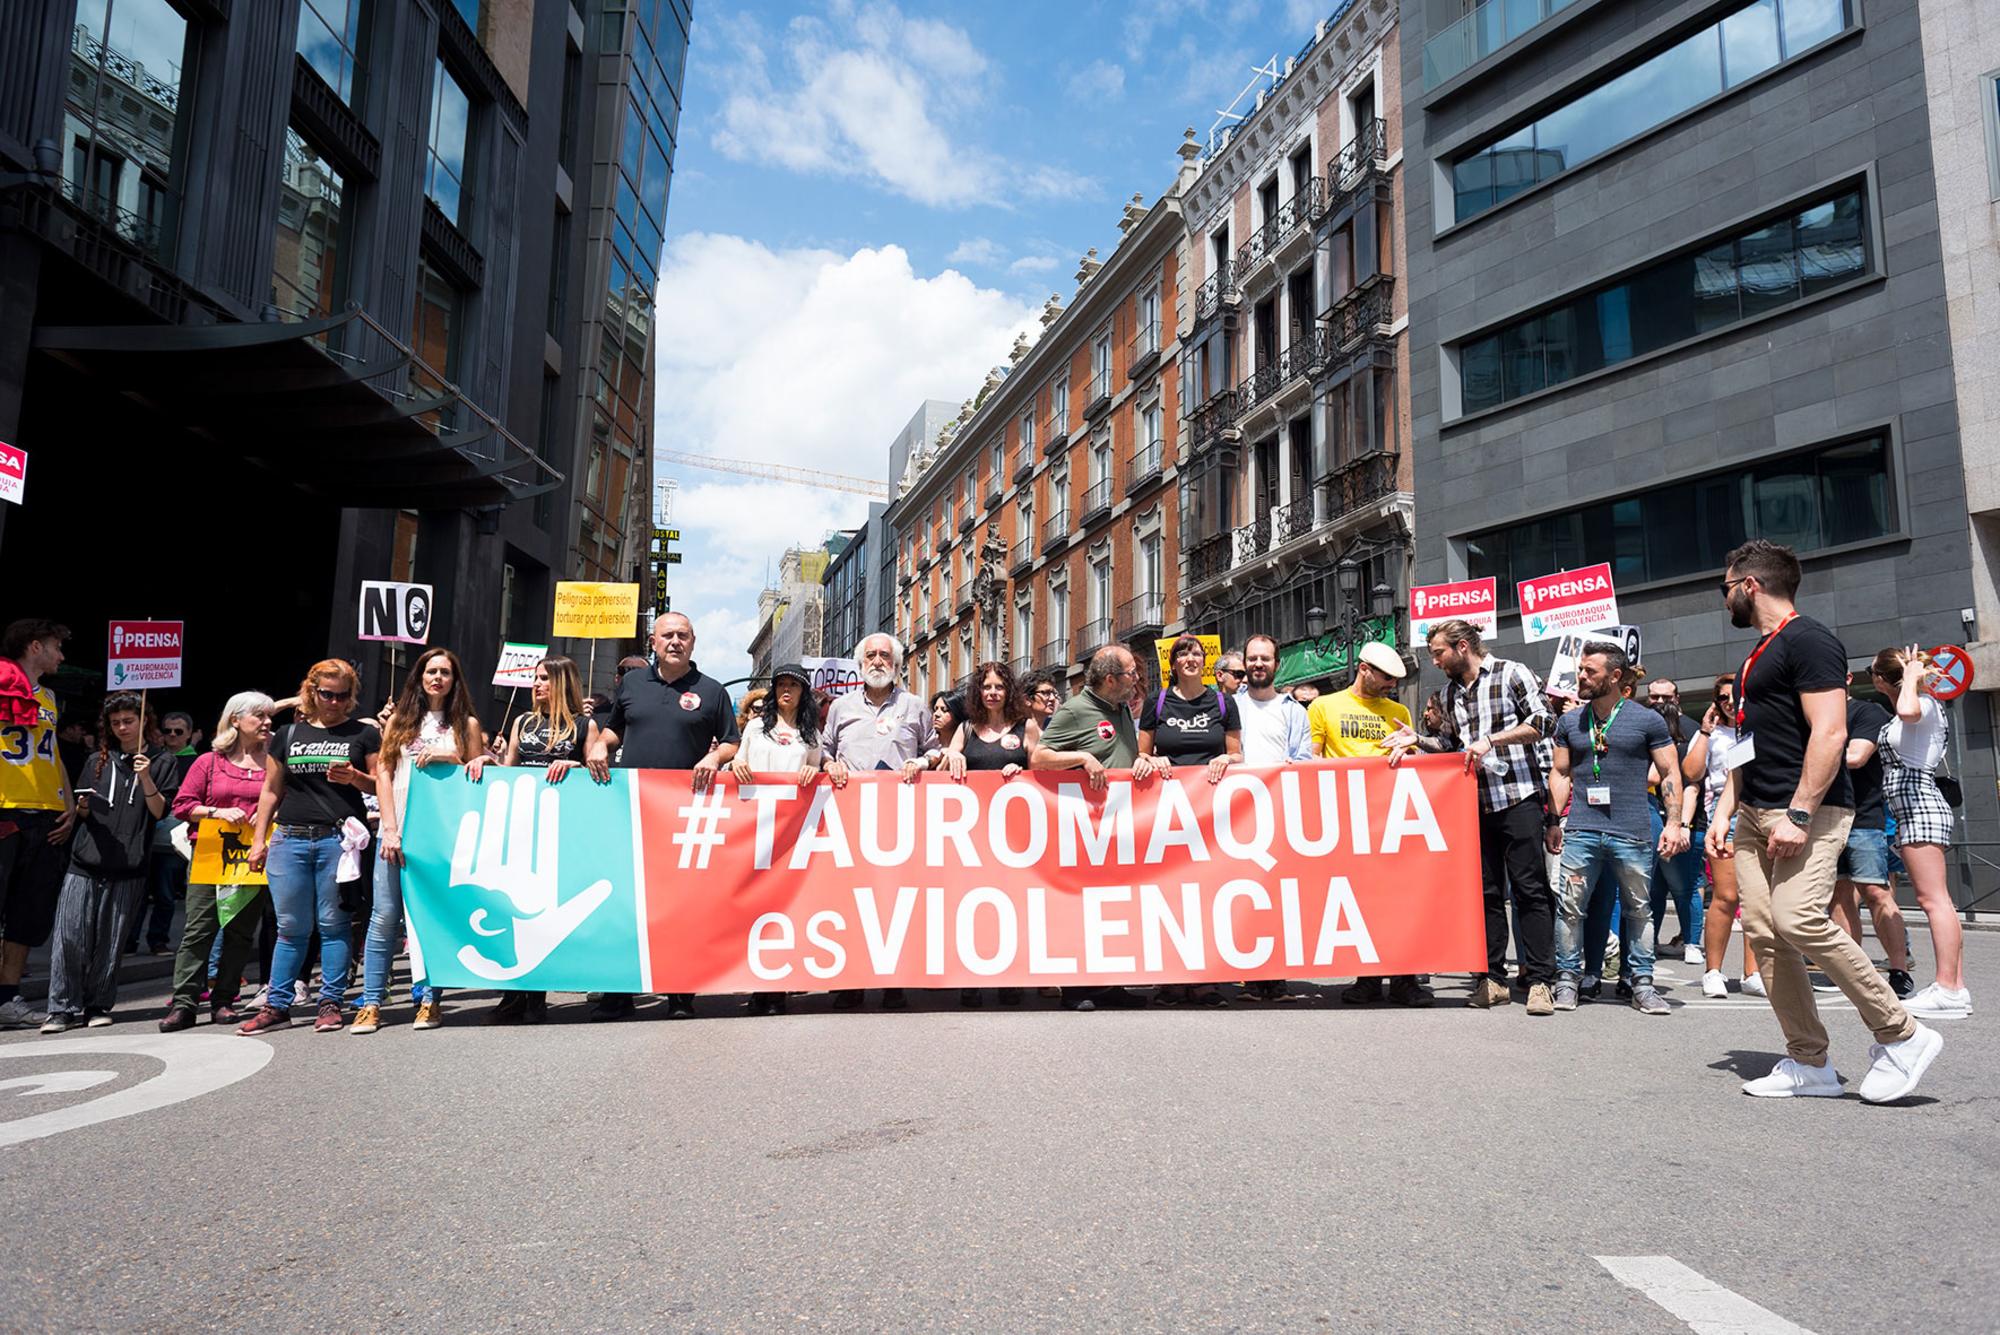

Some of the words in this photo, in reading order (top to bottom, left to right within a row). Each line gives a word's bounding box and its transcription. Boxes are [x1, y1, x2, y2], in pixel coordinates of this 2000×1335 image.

[1537, 575, 1609, 602] PRENSA
[557, 592, 591, 607] Peligrosa
[1428, 588, 1492, 609] PRENSA
[363, 587, 430, 639] NO
[556, 612, 584, 624] torturar
[585, 614, 598, 627] por
[1544, 603, 1612, 623] #TAUROMAQUIA
[125, 633, 179, 647] PRENSA
[126, 663, 178, 672] #TAUROMAQUIA
[131, 671, 174, 681] esVIOLENCIA
[1341, 720, 1359, 738] NO
[1360, 729, 1386, 739] COSAS
[1, 725, 55, 765] 34
[672, 768, 1448, 872] #TAUROMAQUIA
[747, 876, 1380, 981] esVIOLENCIA
